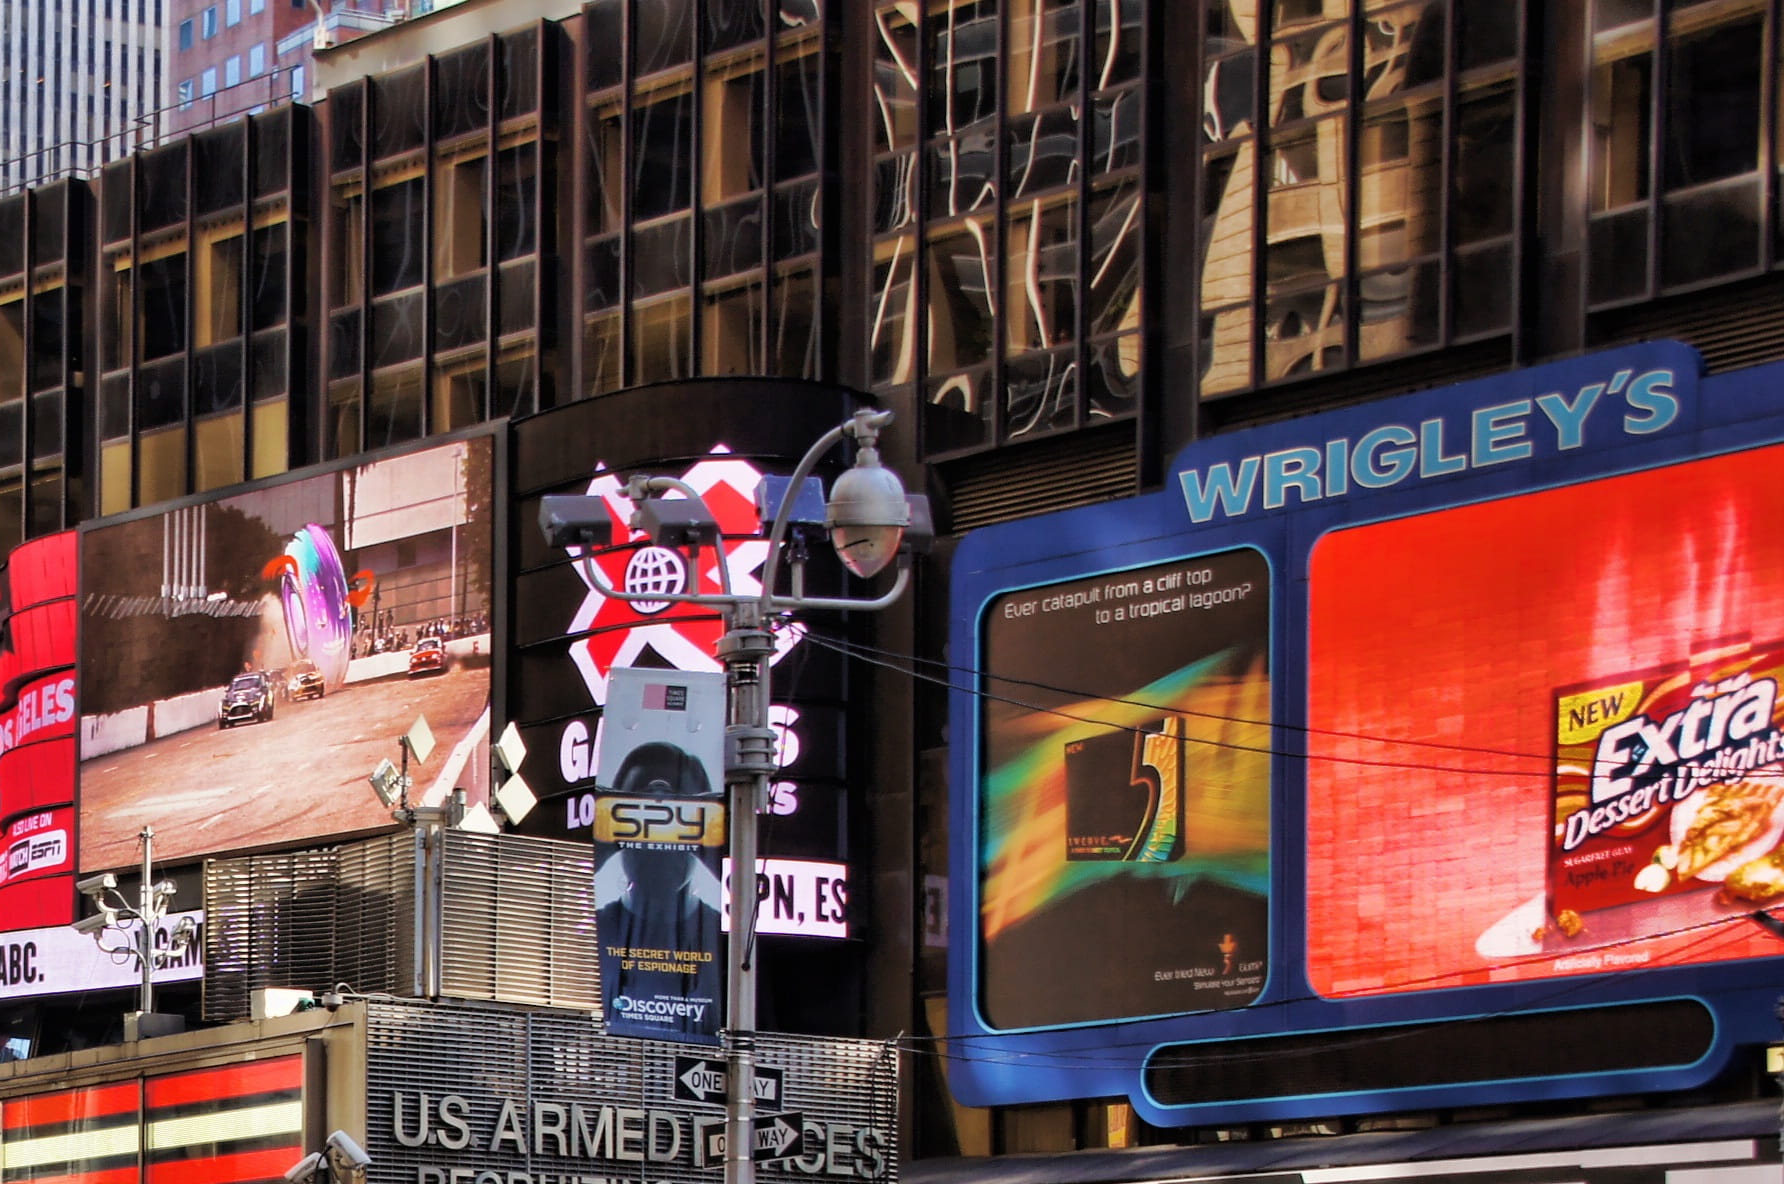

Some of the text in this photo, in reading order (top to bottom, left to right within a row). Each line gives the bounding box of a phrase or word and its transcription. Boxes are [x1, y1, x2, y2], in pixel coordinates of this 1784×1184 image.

[1178, 370, 1680, 524] WRIGLEY'S
[1042, 588, 1100, 612] catapult
[1104, 584, 1138, 601] from
[1142, 581, 1153, 594] a
[1157, 571, 1183, 592] cliff
[1186, 568, 1212, 588] top
[1096, 582, 1251, 625] to a tropical lagoon?
[1569, 692, 1624, 732] NEW
[1592, 677, 1777, 804] Extra
[39, 813, 53, 828] ON
[611, 803, 705, 840] SPY
[1563, 773, 1672, 851] Dessert
[31, 839, 62, 861] ESPN
[618, 841, 699, 851] THE EXHIBIT
[1566, 861, 1635, 887] Apple Pie
[606, 946, 712, 962] THE SECRET WORLD
[622, 960, 697, 974] OF ESPIONAGE
[620, 1012, 674, 1023] TIMES SQUARE
[691, 1071, 722, 1090] ONE
[393, 1091, 681, 1164] U.S. ARMED
[757, 1127, 789, 1148] WAY
